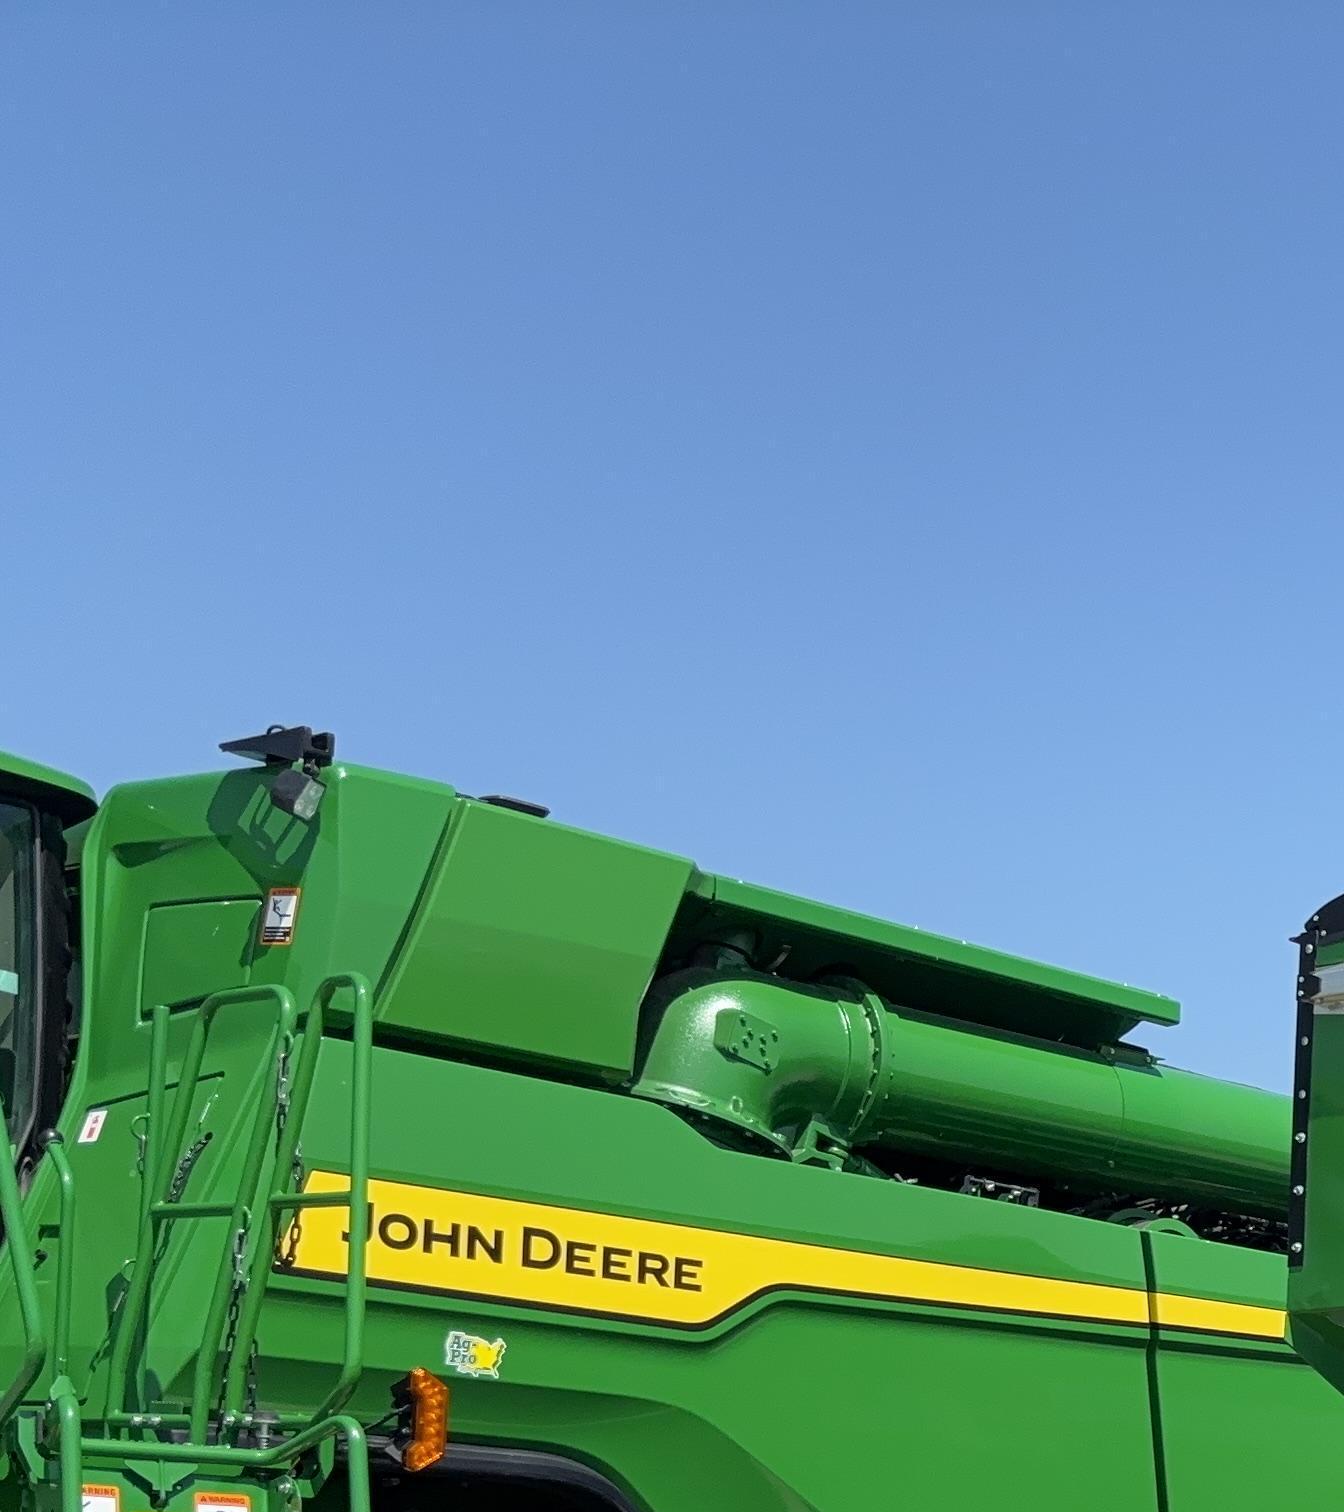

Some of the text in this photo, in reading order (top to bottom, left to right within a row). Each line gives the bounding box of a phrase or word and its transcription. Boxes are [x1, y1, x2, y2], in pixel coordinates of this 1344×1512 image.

[342, 1201, 704, 1293] JOHN DEERE
[450, 1335, 477, 1352] Ag-
[450, 1350, 476, 1364] Pro
[208, 1495, 245, 1505] WARNING
